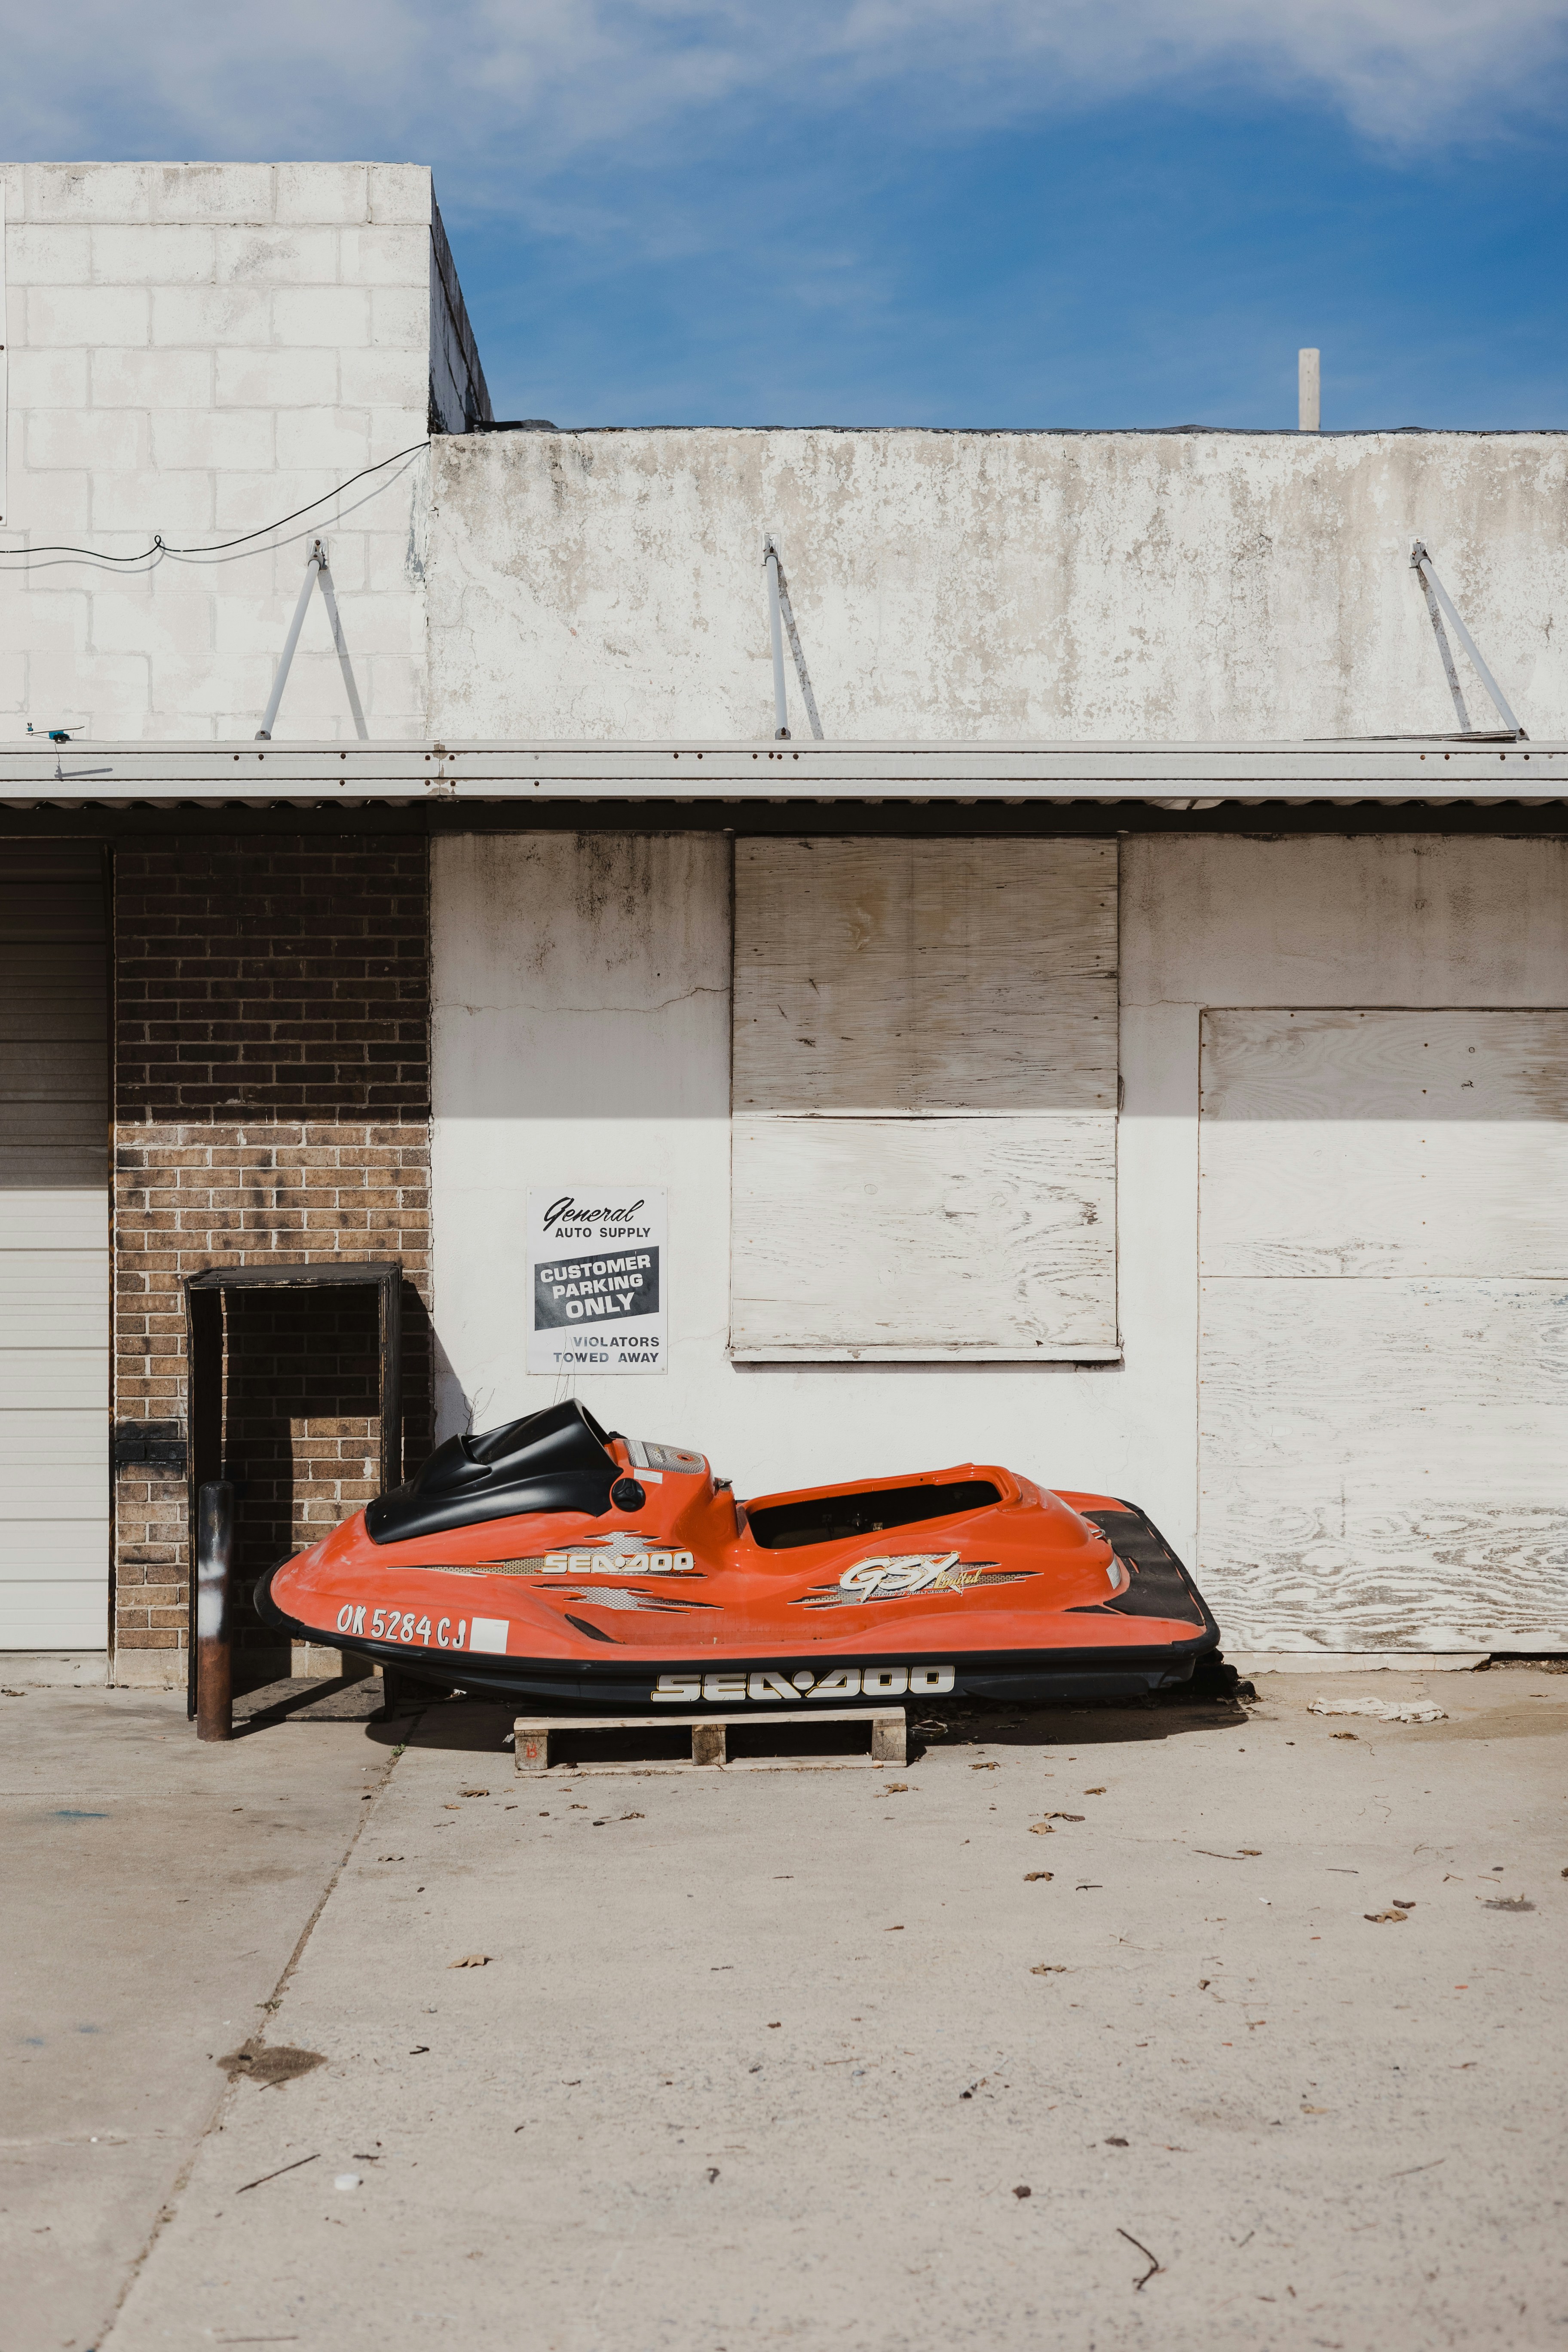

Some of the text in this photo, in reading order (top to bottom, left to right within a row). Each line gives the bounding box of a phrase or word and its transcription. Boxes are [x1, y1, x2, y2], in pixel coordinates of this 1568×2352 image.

[543, 1197, 645, 1232] General
[555, 1228, 651, 1238] AUTO SUPPLY
[540, 1254, 651, 1283] CUSTOMER
[552, 1273, 643, 1299] PARKING
[565, 1292, 635, 1319] ONLY
[573, 1337, 660, 1347] VIOLATORS
[553, 1352, 659, 1363] TOWED AWAY
[839, 1551, 963, 1603] GSX
[933, 1569, 982, 1589] Limited
[337, 1604, 467, 1649] OK 5284 CJ
